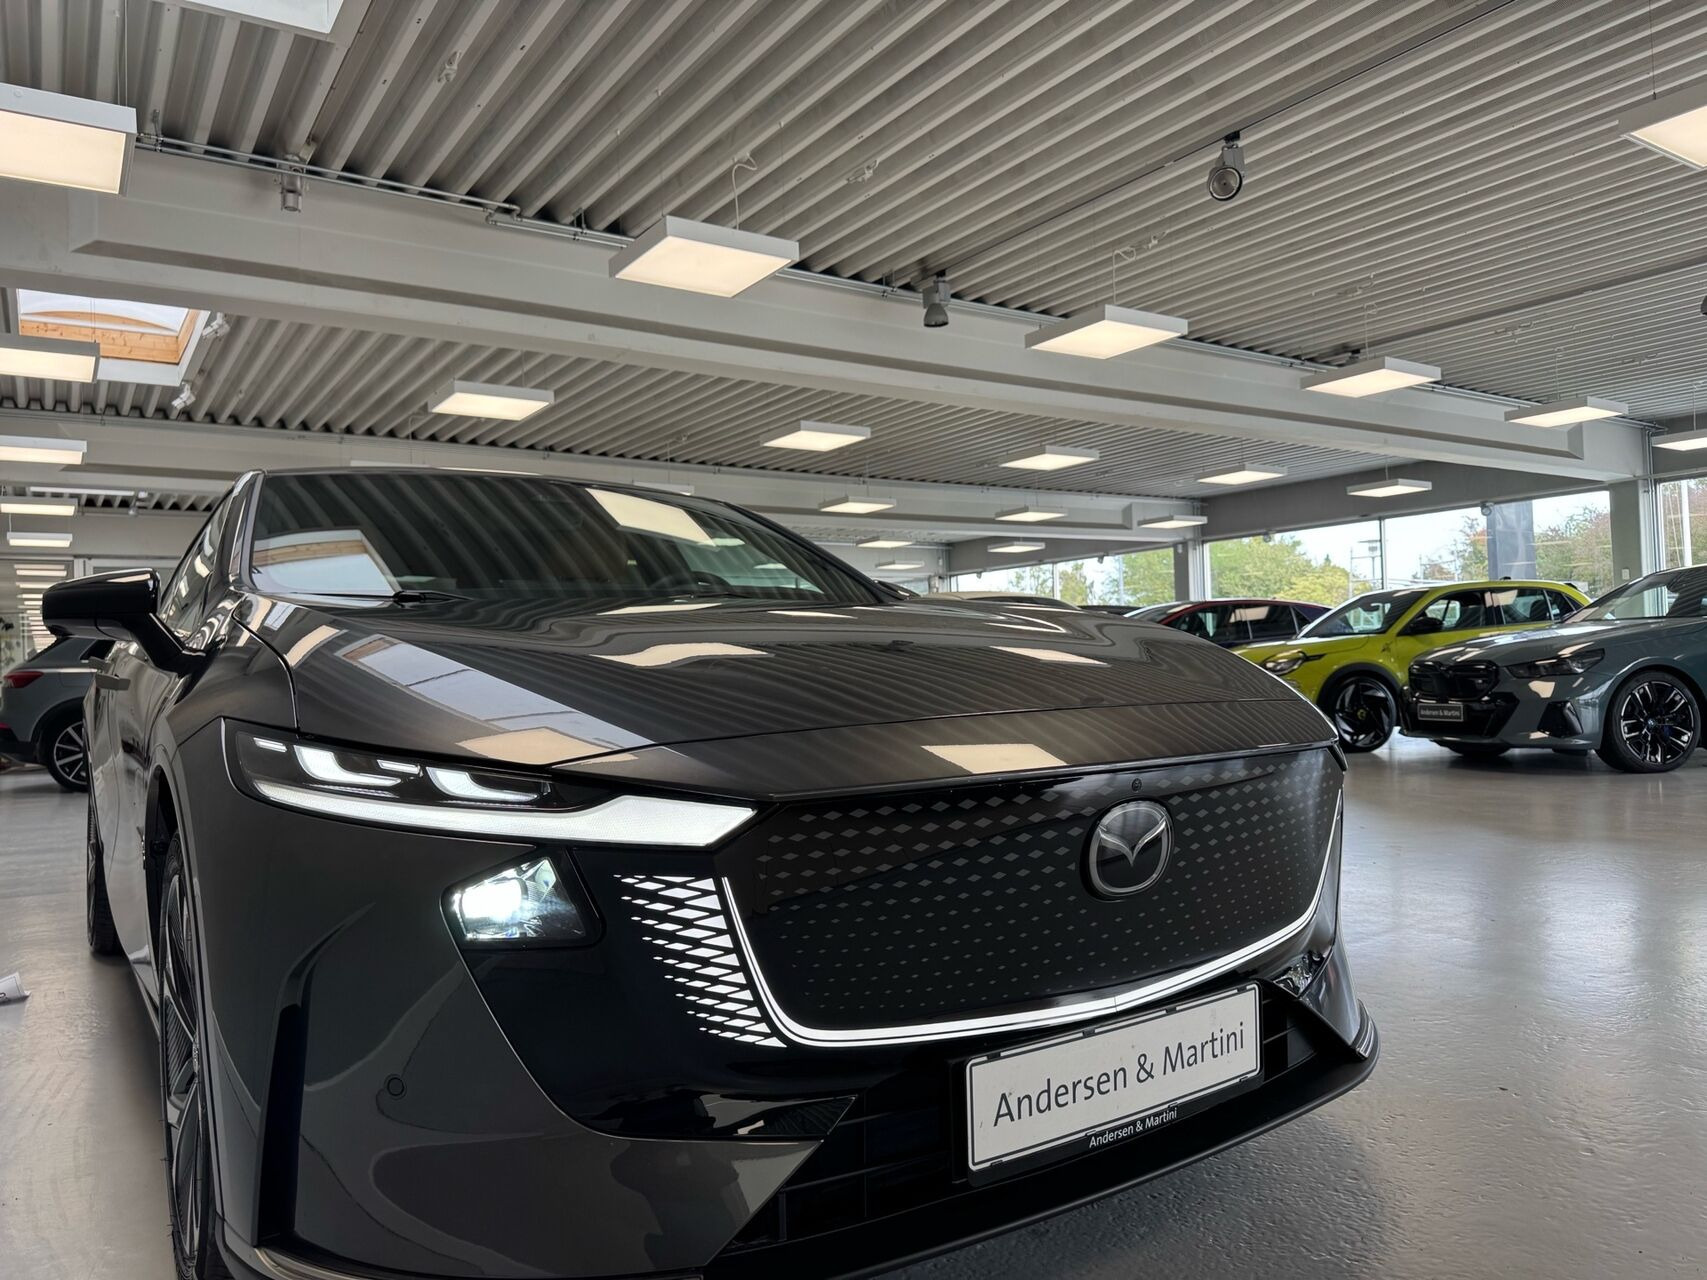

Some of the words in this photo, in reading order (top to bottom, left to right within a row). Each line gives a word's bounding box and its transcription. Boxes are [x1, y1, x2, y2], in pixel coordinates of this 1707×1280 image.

[993, 1065, 1127, 1127] Andersen
[1136, 1053, 1155, 1084] &
[1162, 1021, 1244, 1076] Martini
[1089, 1126, 1134, 1148] Andersen
[1135, 1121, 1144, 1132] &
[1145, 1107, 1178, 1129] Martini
